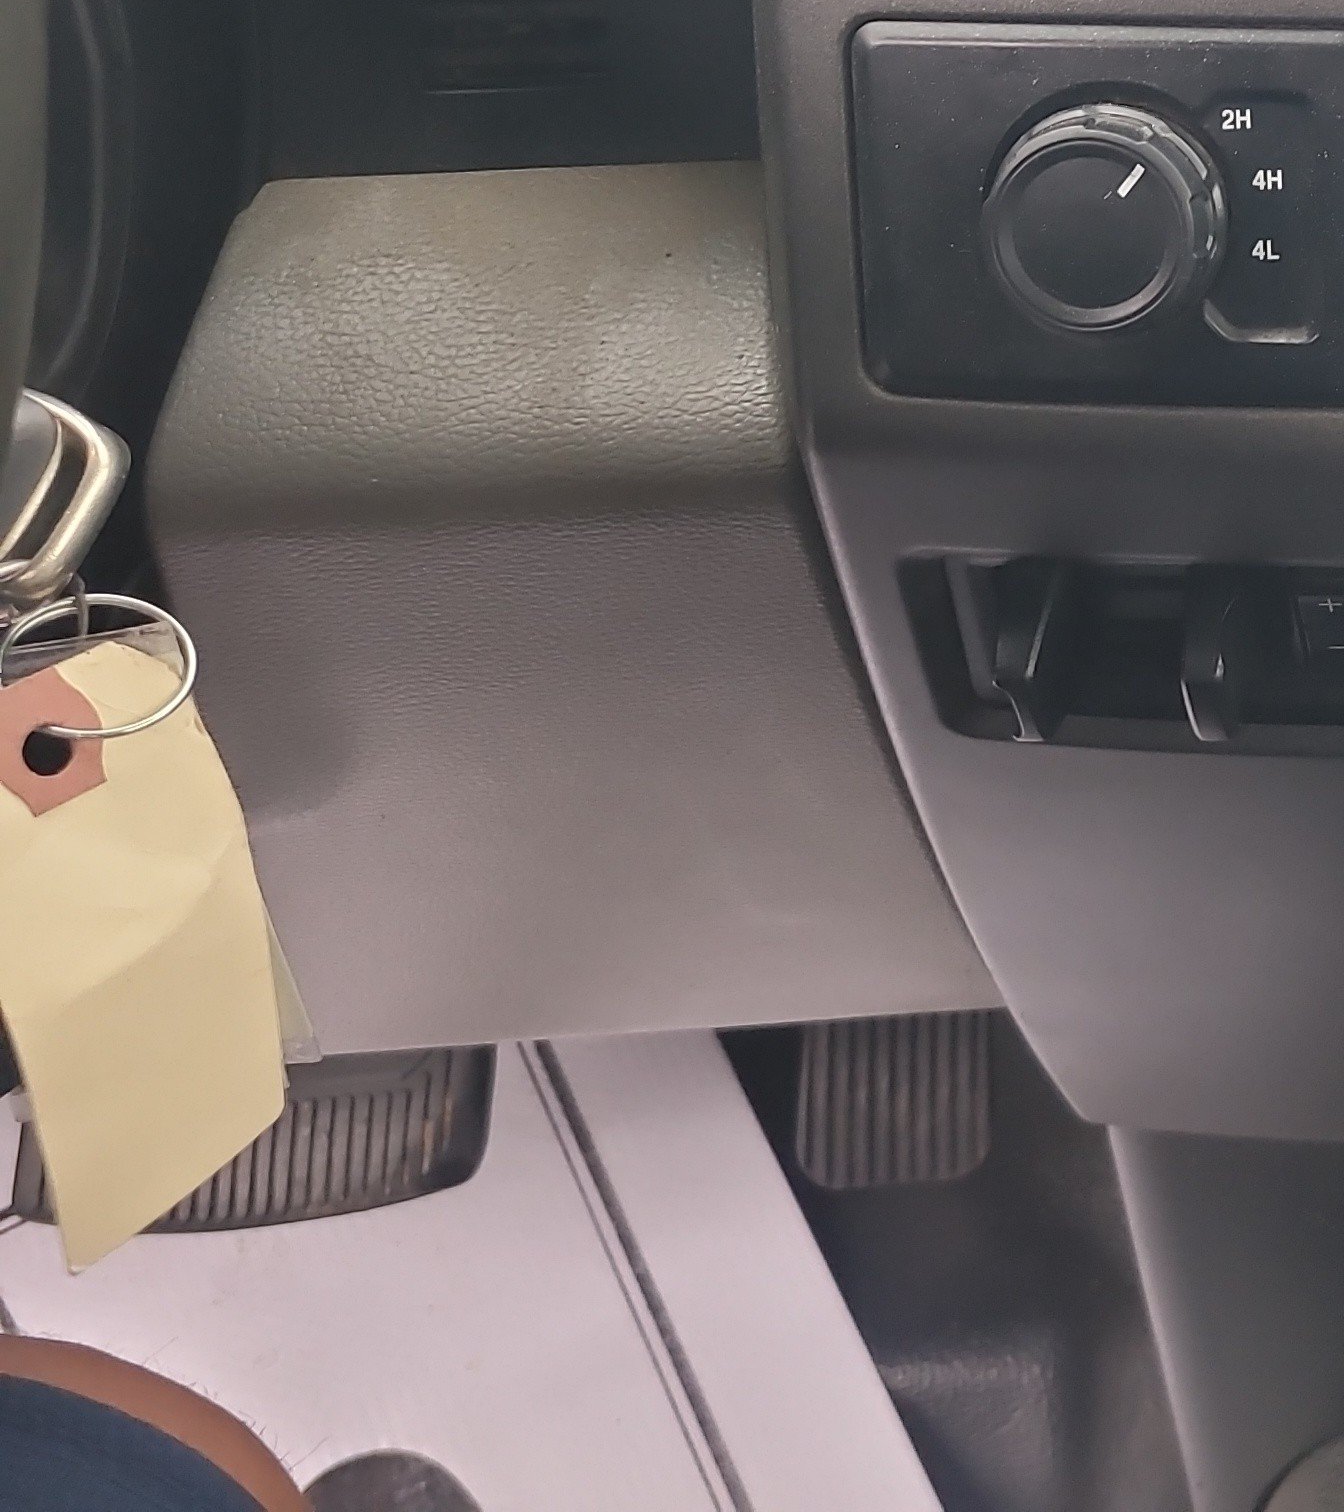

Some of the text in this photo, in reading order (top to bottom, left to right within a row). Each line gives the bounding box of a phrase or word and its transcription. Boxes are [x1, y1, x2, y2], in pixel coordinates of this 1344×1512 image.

[1220, 108, 1253, 131] 2H
[1251, 169, 1284, 191] 4H
[1251, 239, 1281, 261] 4L
